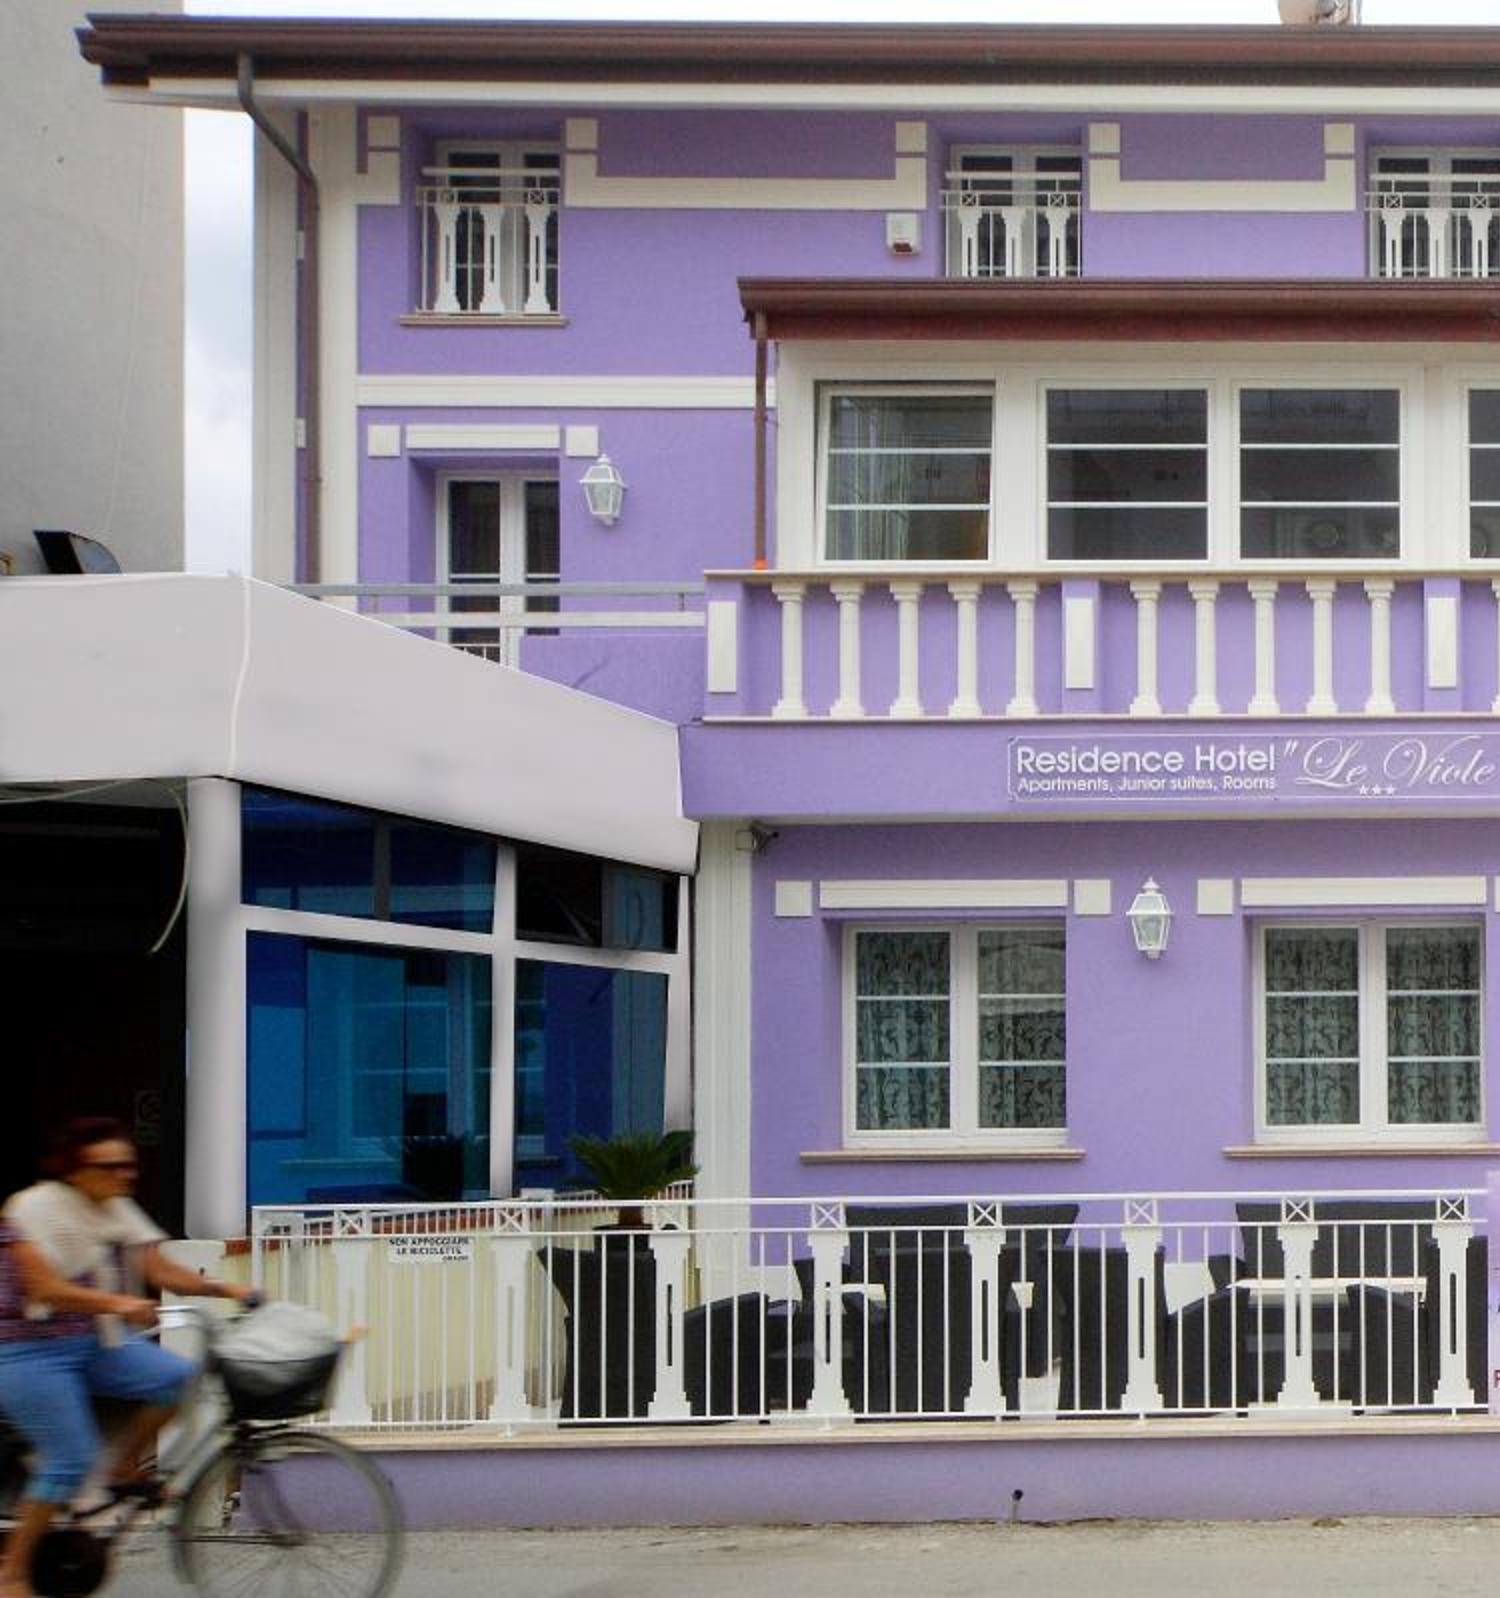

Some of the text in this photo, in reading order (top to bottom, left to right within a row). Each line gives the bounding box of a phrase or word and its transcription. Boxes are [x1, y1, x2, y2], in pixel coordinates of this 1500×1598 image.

[1017, 745, 1185, 773] Residence
[1195, 743, 1275, 772] Hotel
[1018, 774, 1277, 793] Apartments, Junior suites, Rooms
